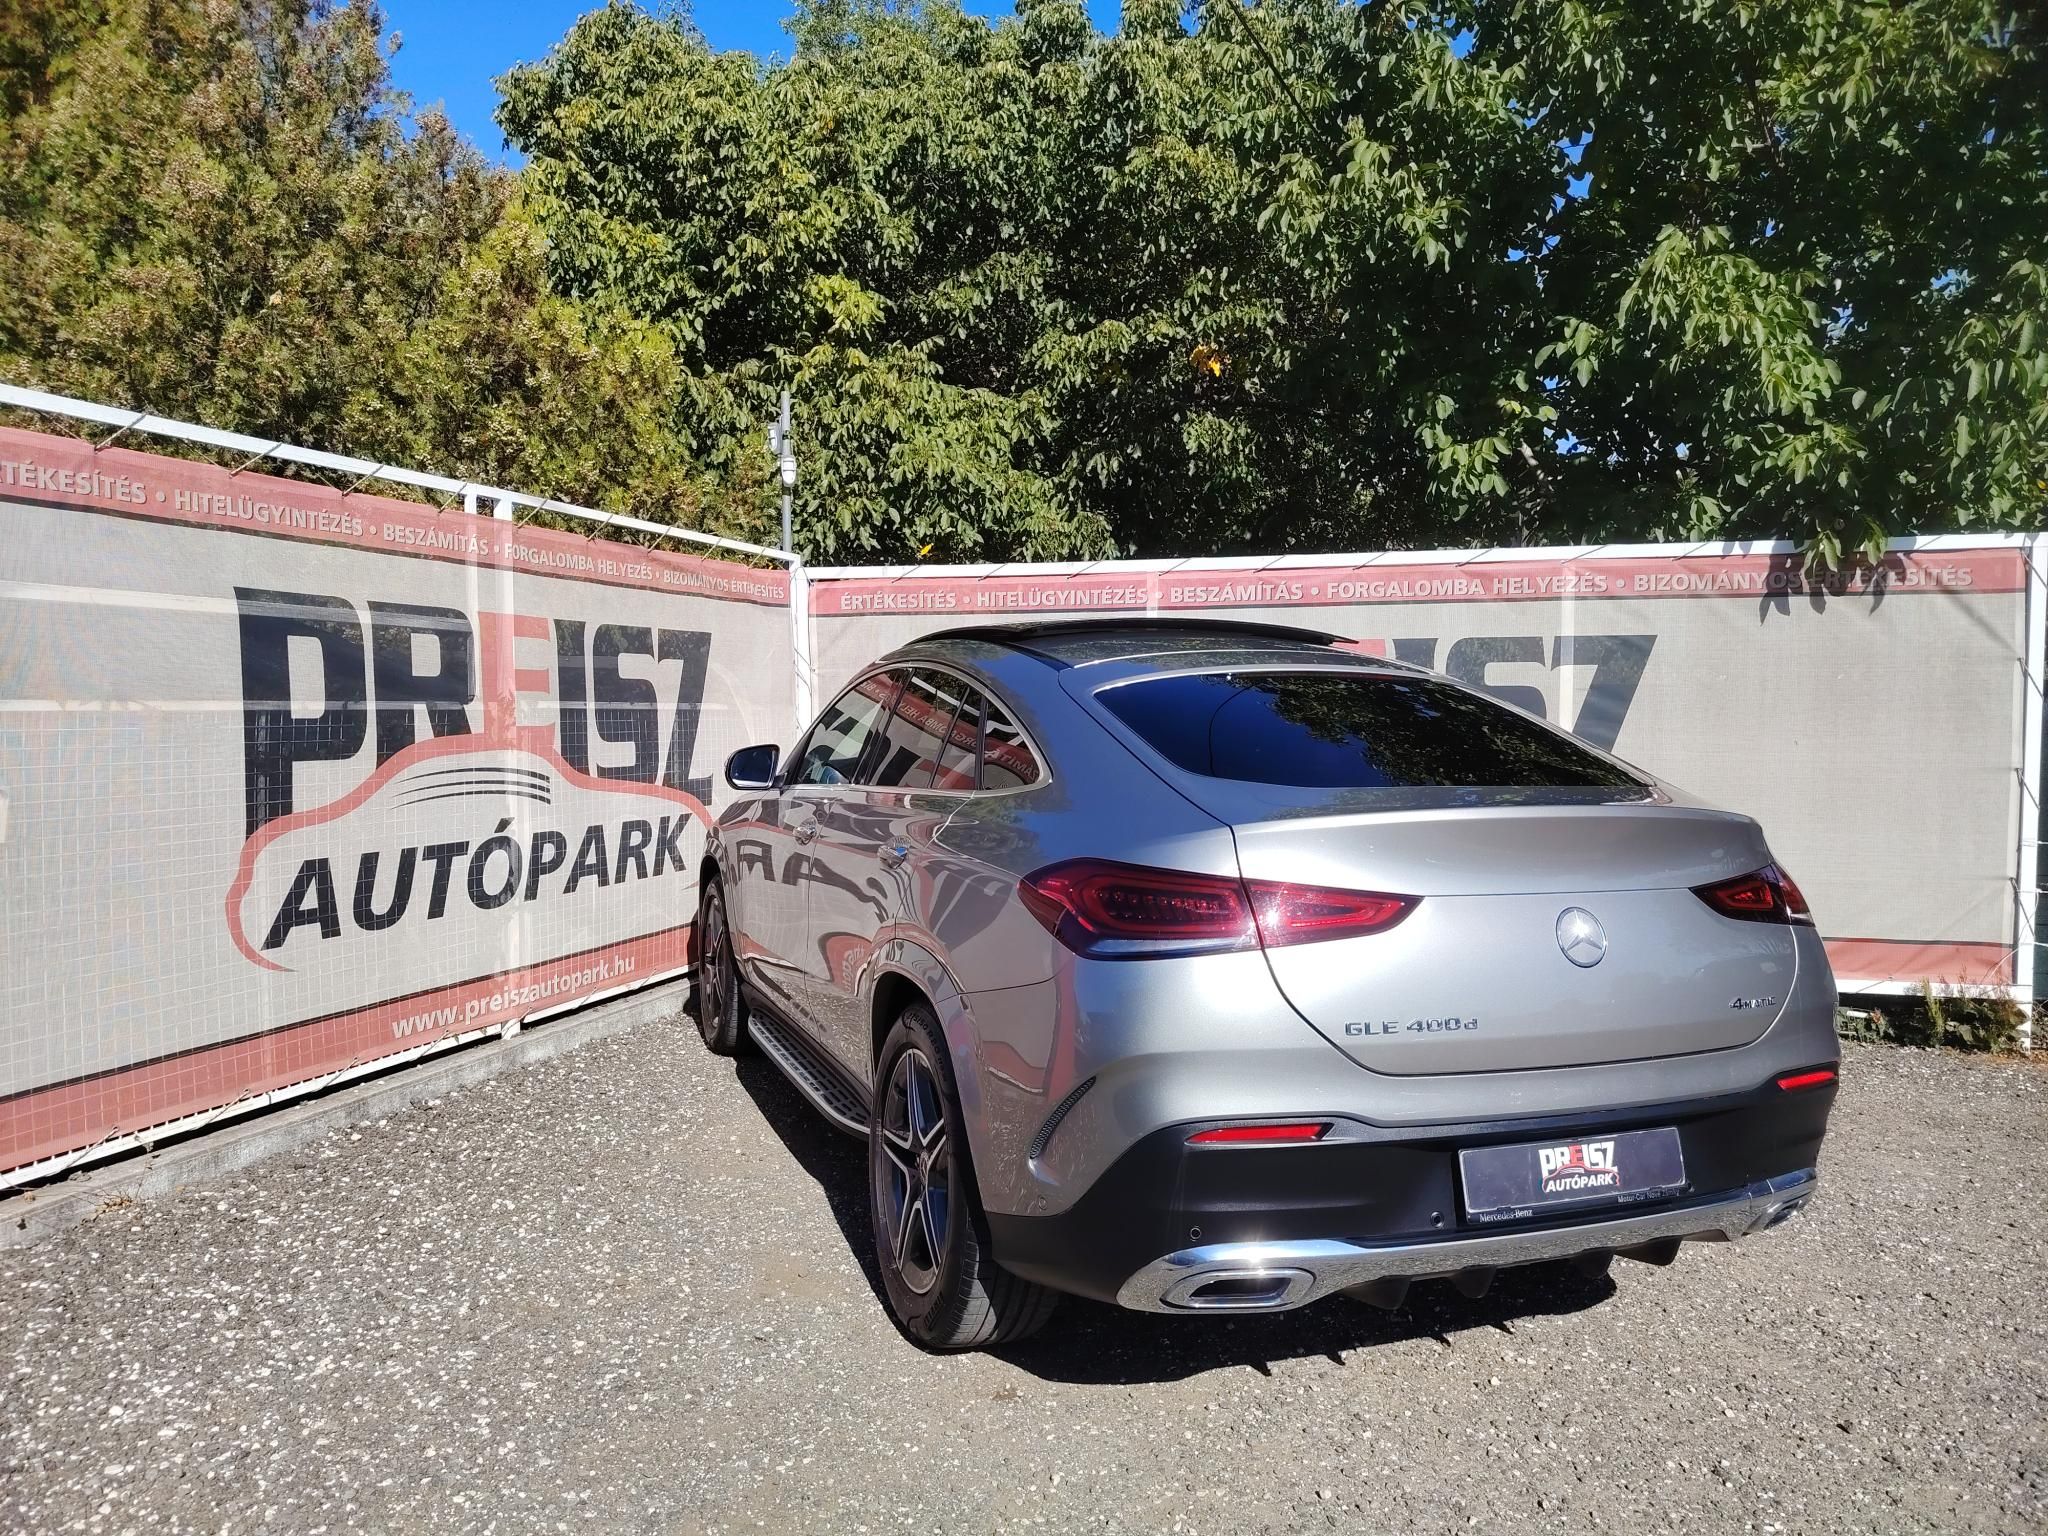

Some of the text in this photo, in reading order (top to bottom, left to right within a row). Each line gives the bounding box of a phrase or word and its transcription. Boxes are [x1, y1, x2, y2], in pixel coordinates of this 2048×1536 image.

[0, 459, 147, 504] TÉKESÍTÉS
[174, 489, 363, 537] HITELÜGYINTÉZÉS
[383, 523, 489, 556] BESZÁMÍTÁS
[504, 543, 595, 571] FORGALOMBA
[598, 559, 652, 580] HELYEZÉS
[663, 569, 729, 592] BIZOMÁNYOS
[840, 588, 957, 610] ÉRTÉKESÍTÉS
[977, 582, 1149, 607] HITELÜGYINTÉZÉS
[1170, 579, 1303, 603] BESZÁMÍTÁS
[1327, 579, 1483, 600] FORGALOMBA
[1493, 572, 1609, 594] HELYEZÉS
[1633, 567, 1801, 592] BIZOMÁNYOS
[233, 586, 713, 842] PREISZ
[261, 813, 692, 950] AUTÓPARK
[392, 955, 635, 1039] www.preiszautopark.hu
[1344, 1020, 1400, 1036] GLE
[1538, 1141, 1618, 1177] PREISZ
[1545, 1173, 1613, 1193] AUTÓPARK
[1479, 1209, 1533, 1222] Mercedes-Benz
